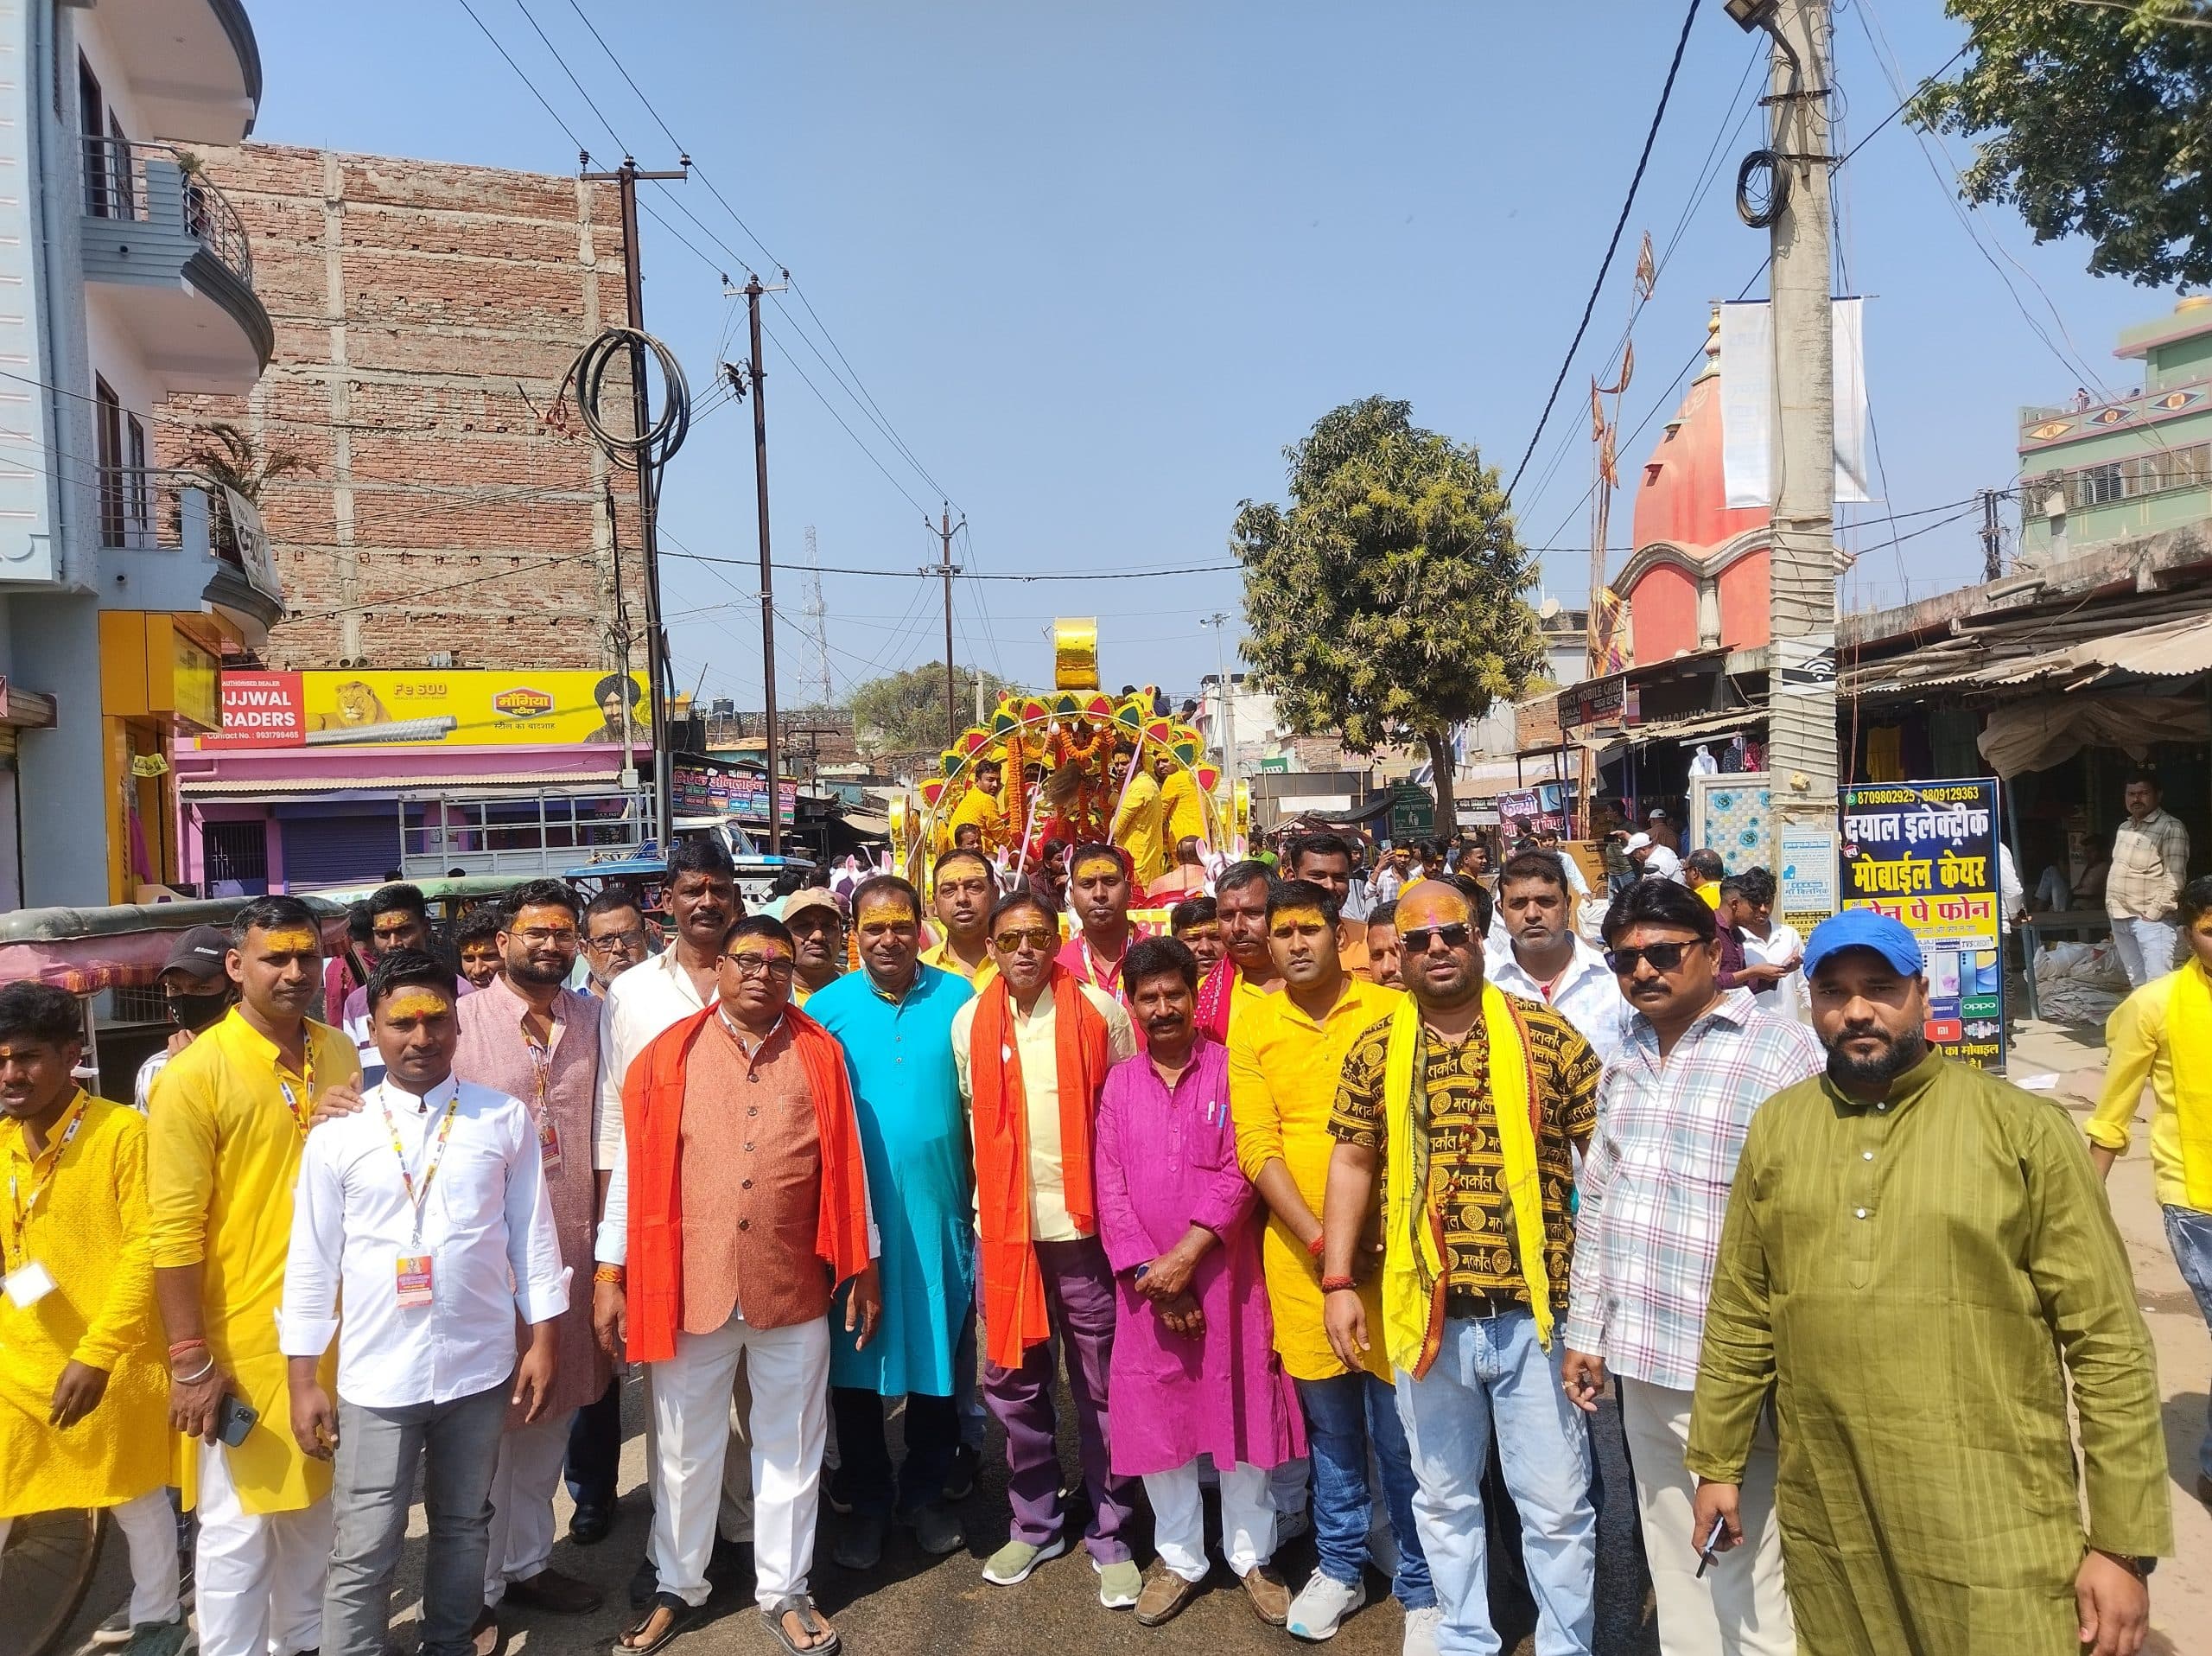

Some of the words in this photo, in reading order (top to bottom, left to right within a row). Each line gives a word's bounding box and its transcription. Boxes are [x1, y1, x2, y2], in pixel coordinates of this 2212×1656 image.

[393, 683, 414, 695] Fe
[416, 683, 448, 696] 600
[1577, 686, 1603, 703] MOBILE
[1604, 679, 1623, 696] CARE
[222, 711, 296, 727] RADERS
[493, 721, 512, 729] स्टील
[1858, 790, 1916, 805] 8709802925
[1923, 787, 1980, 801] 8809129363
[1844, 813, 1901, 843] दयाल
[1904, 802, 1989, 845] इलेक्ट्रीक
[1852, 850, 1933, 895] मोबाईल
[1937, 850, 1986, 889] केयर
[1910, 897, 1929, 922] पे
[1936, 895, 1991, 921] फोन
[1945, 1046, 1959, 1056] का
[1961, 1042, 1999, 1056] मोबाइल
